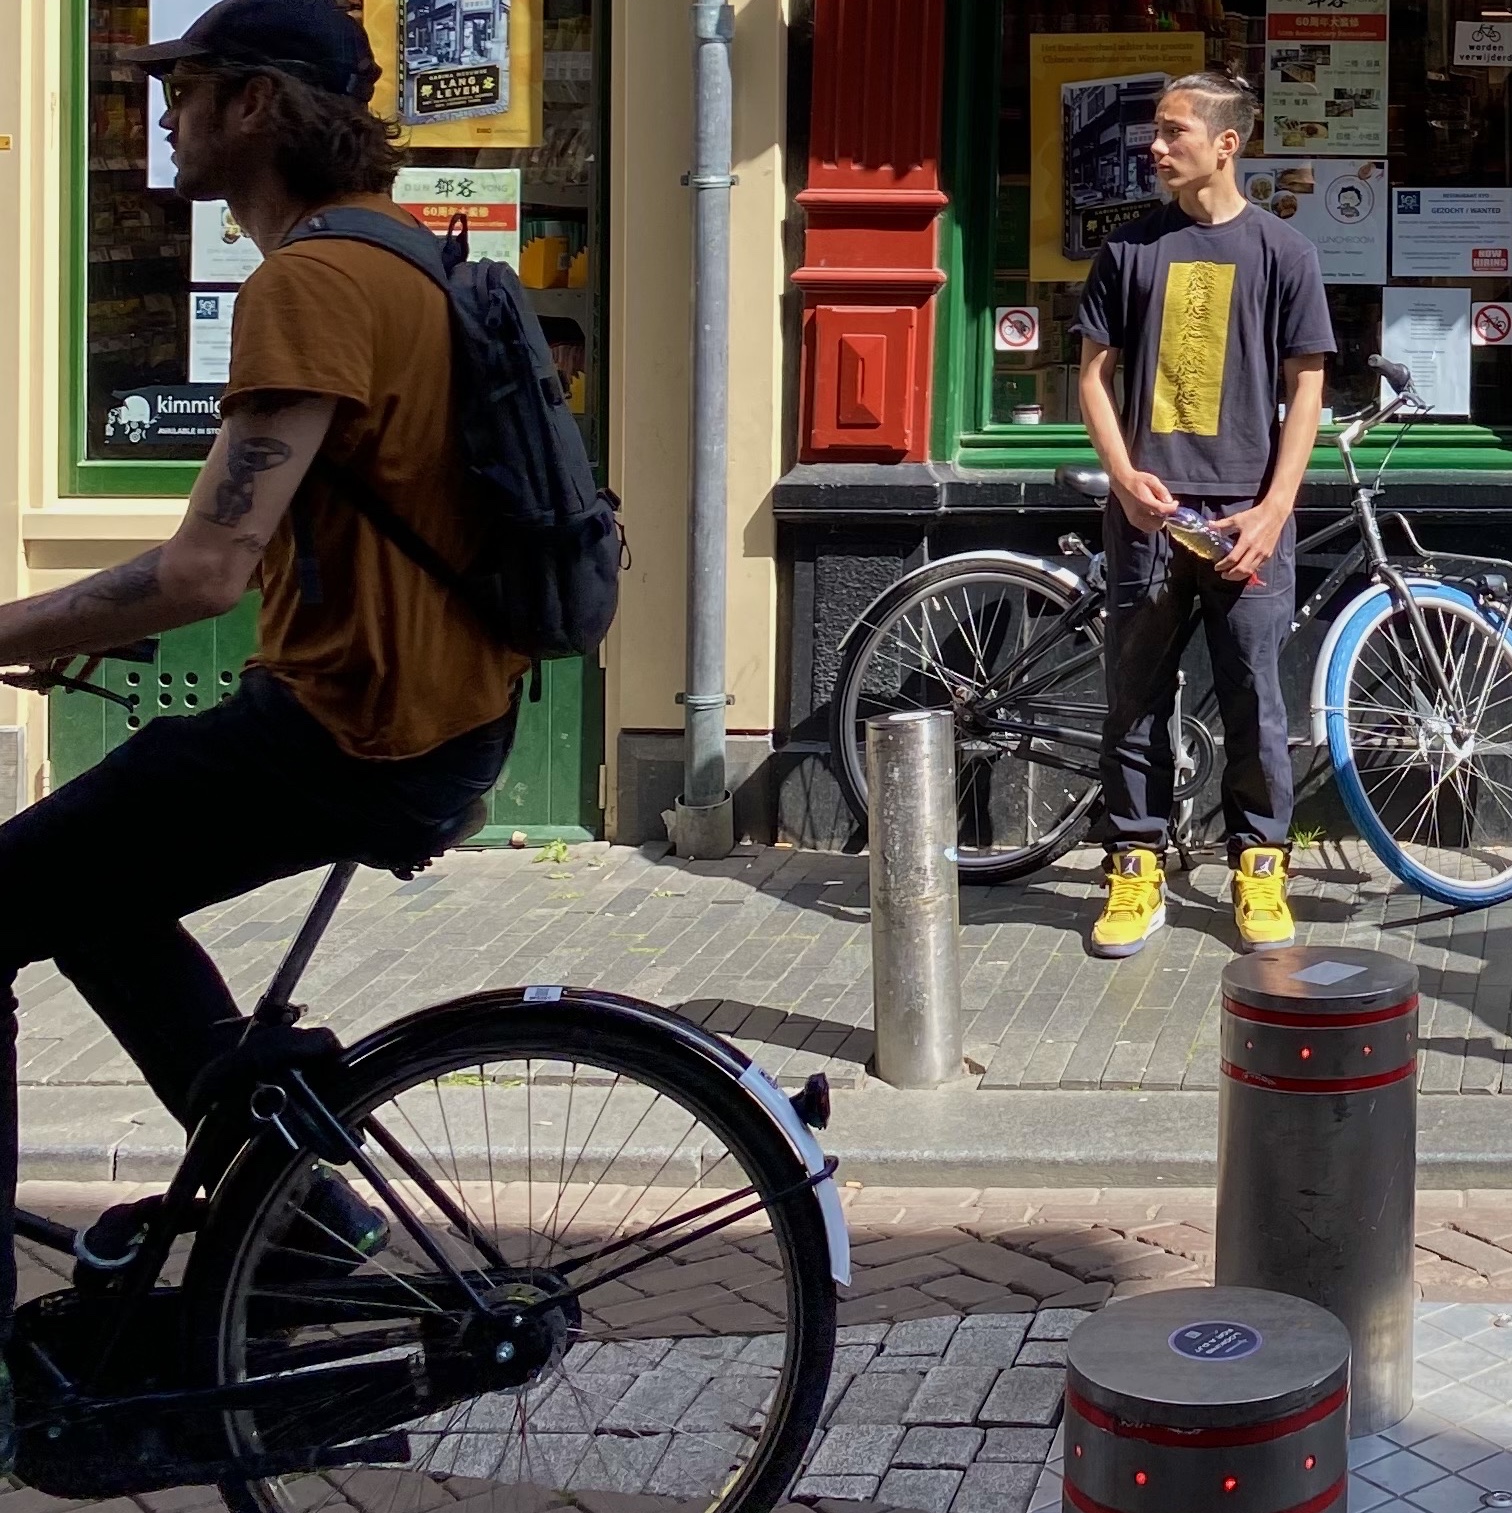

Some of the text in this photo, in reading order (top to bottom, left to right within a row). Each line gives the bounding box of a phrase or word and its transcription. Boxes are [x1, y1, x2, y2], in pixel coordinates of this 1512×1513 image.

[1459, 53, 1512, 63] verwijderd
[439, 76, 476, 88] LANG
[436, 85, 480, 99] LEVEN
[1105, 211, 1140, 223] LANG
[1317, 235, 1375, 244] LUNCHROOM
[1478, 250, 1502, 258] NOW
[1473, 258, 1507, 267] HIRING
